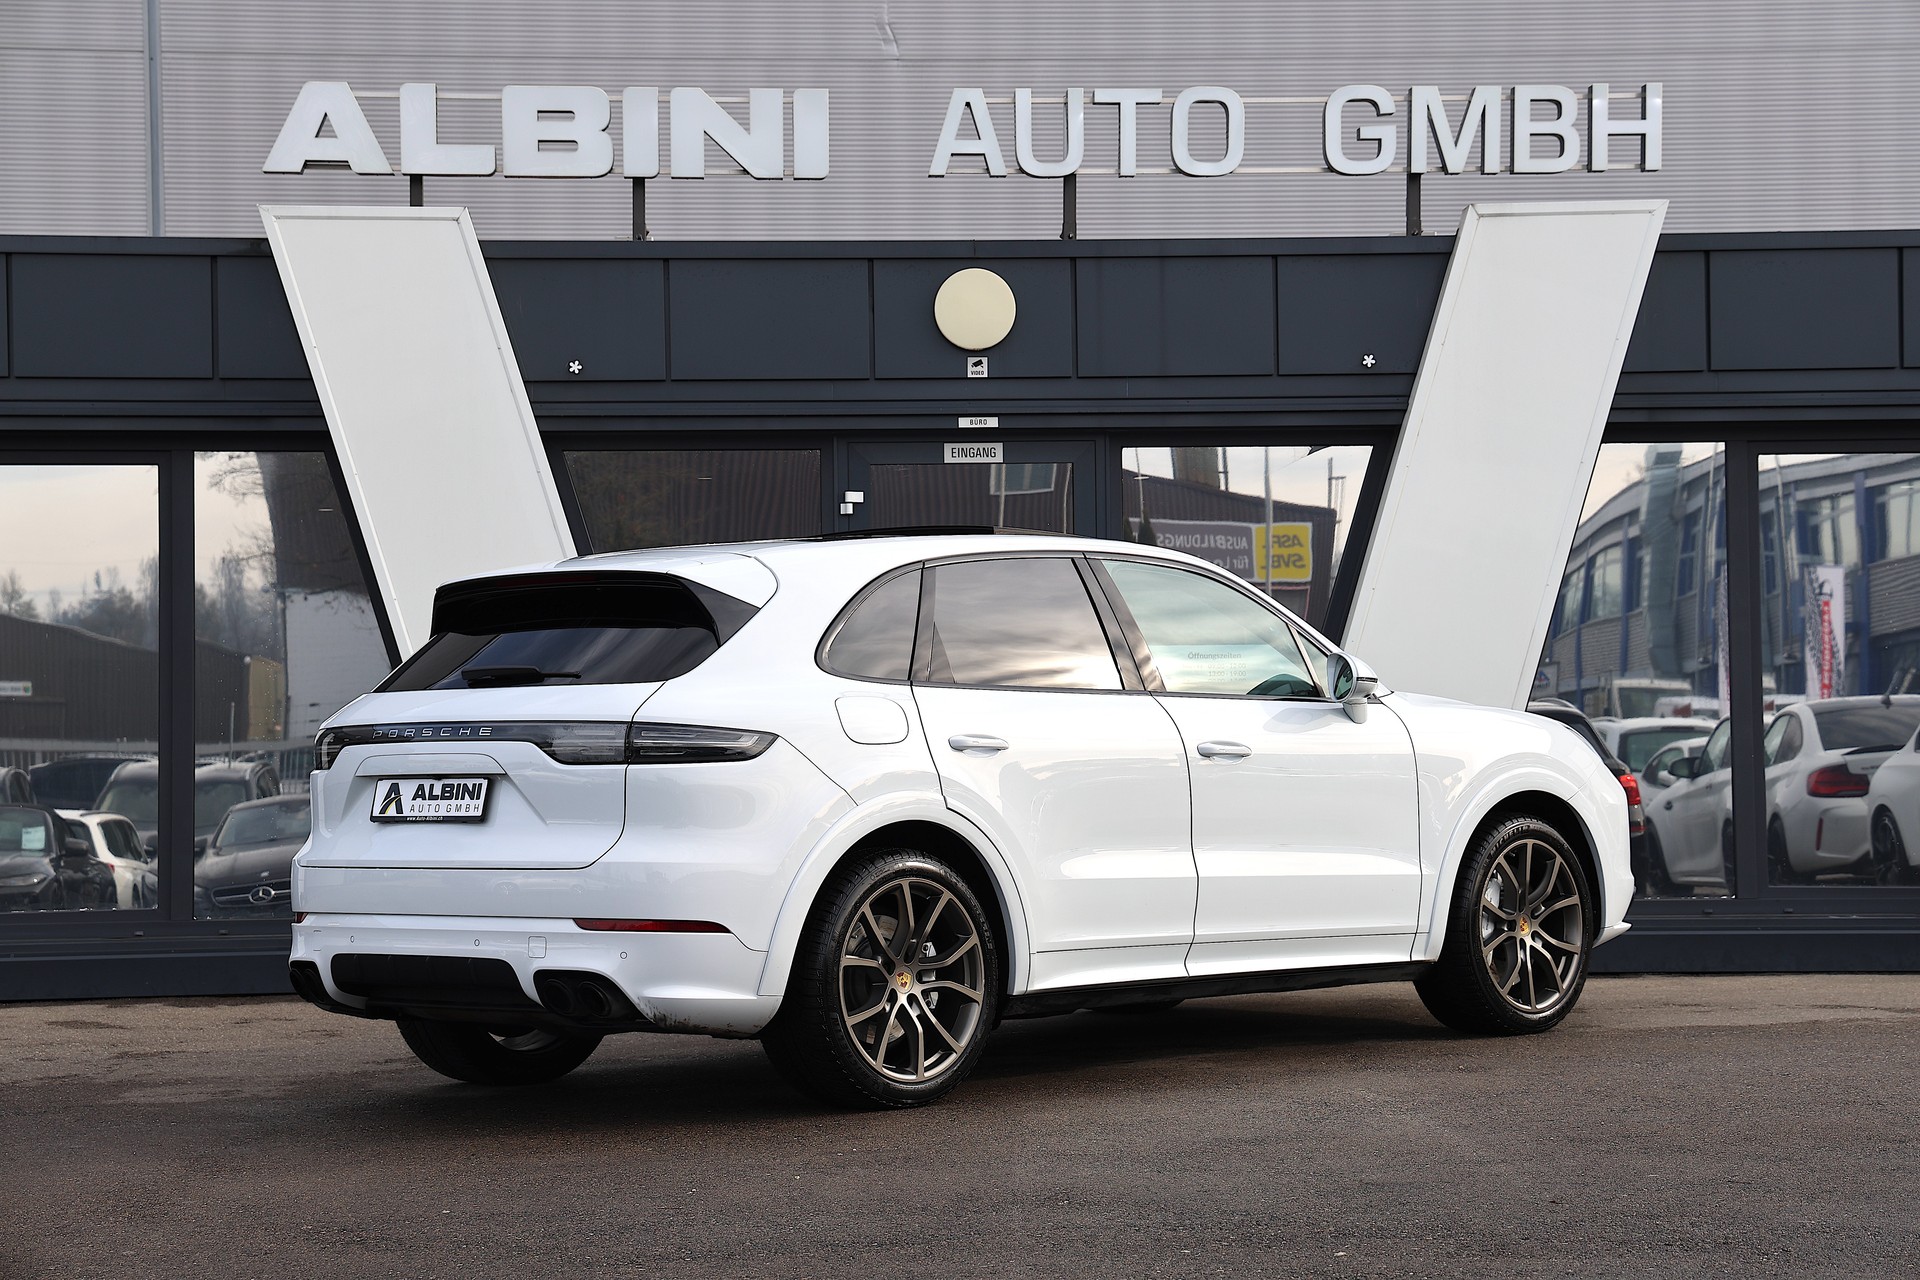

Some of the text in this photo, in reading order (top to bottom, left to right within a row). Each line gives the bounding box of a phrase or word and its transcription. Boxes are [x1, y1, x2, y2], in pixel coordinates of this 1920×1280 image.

[262, 81, 1663, 180] ALBINI AUTO GMBH
[969, 417, 988, 426] BÜRO
[951, 447, 997, 458] EINGANG
[1187, 651, 1242, 660] Öffnungszeiten
[372, 727, 493, 739] PORSCHE
[411, 782, 483, 801] ALBINI
[409, 803, 480, 813] AUTO GMBH
